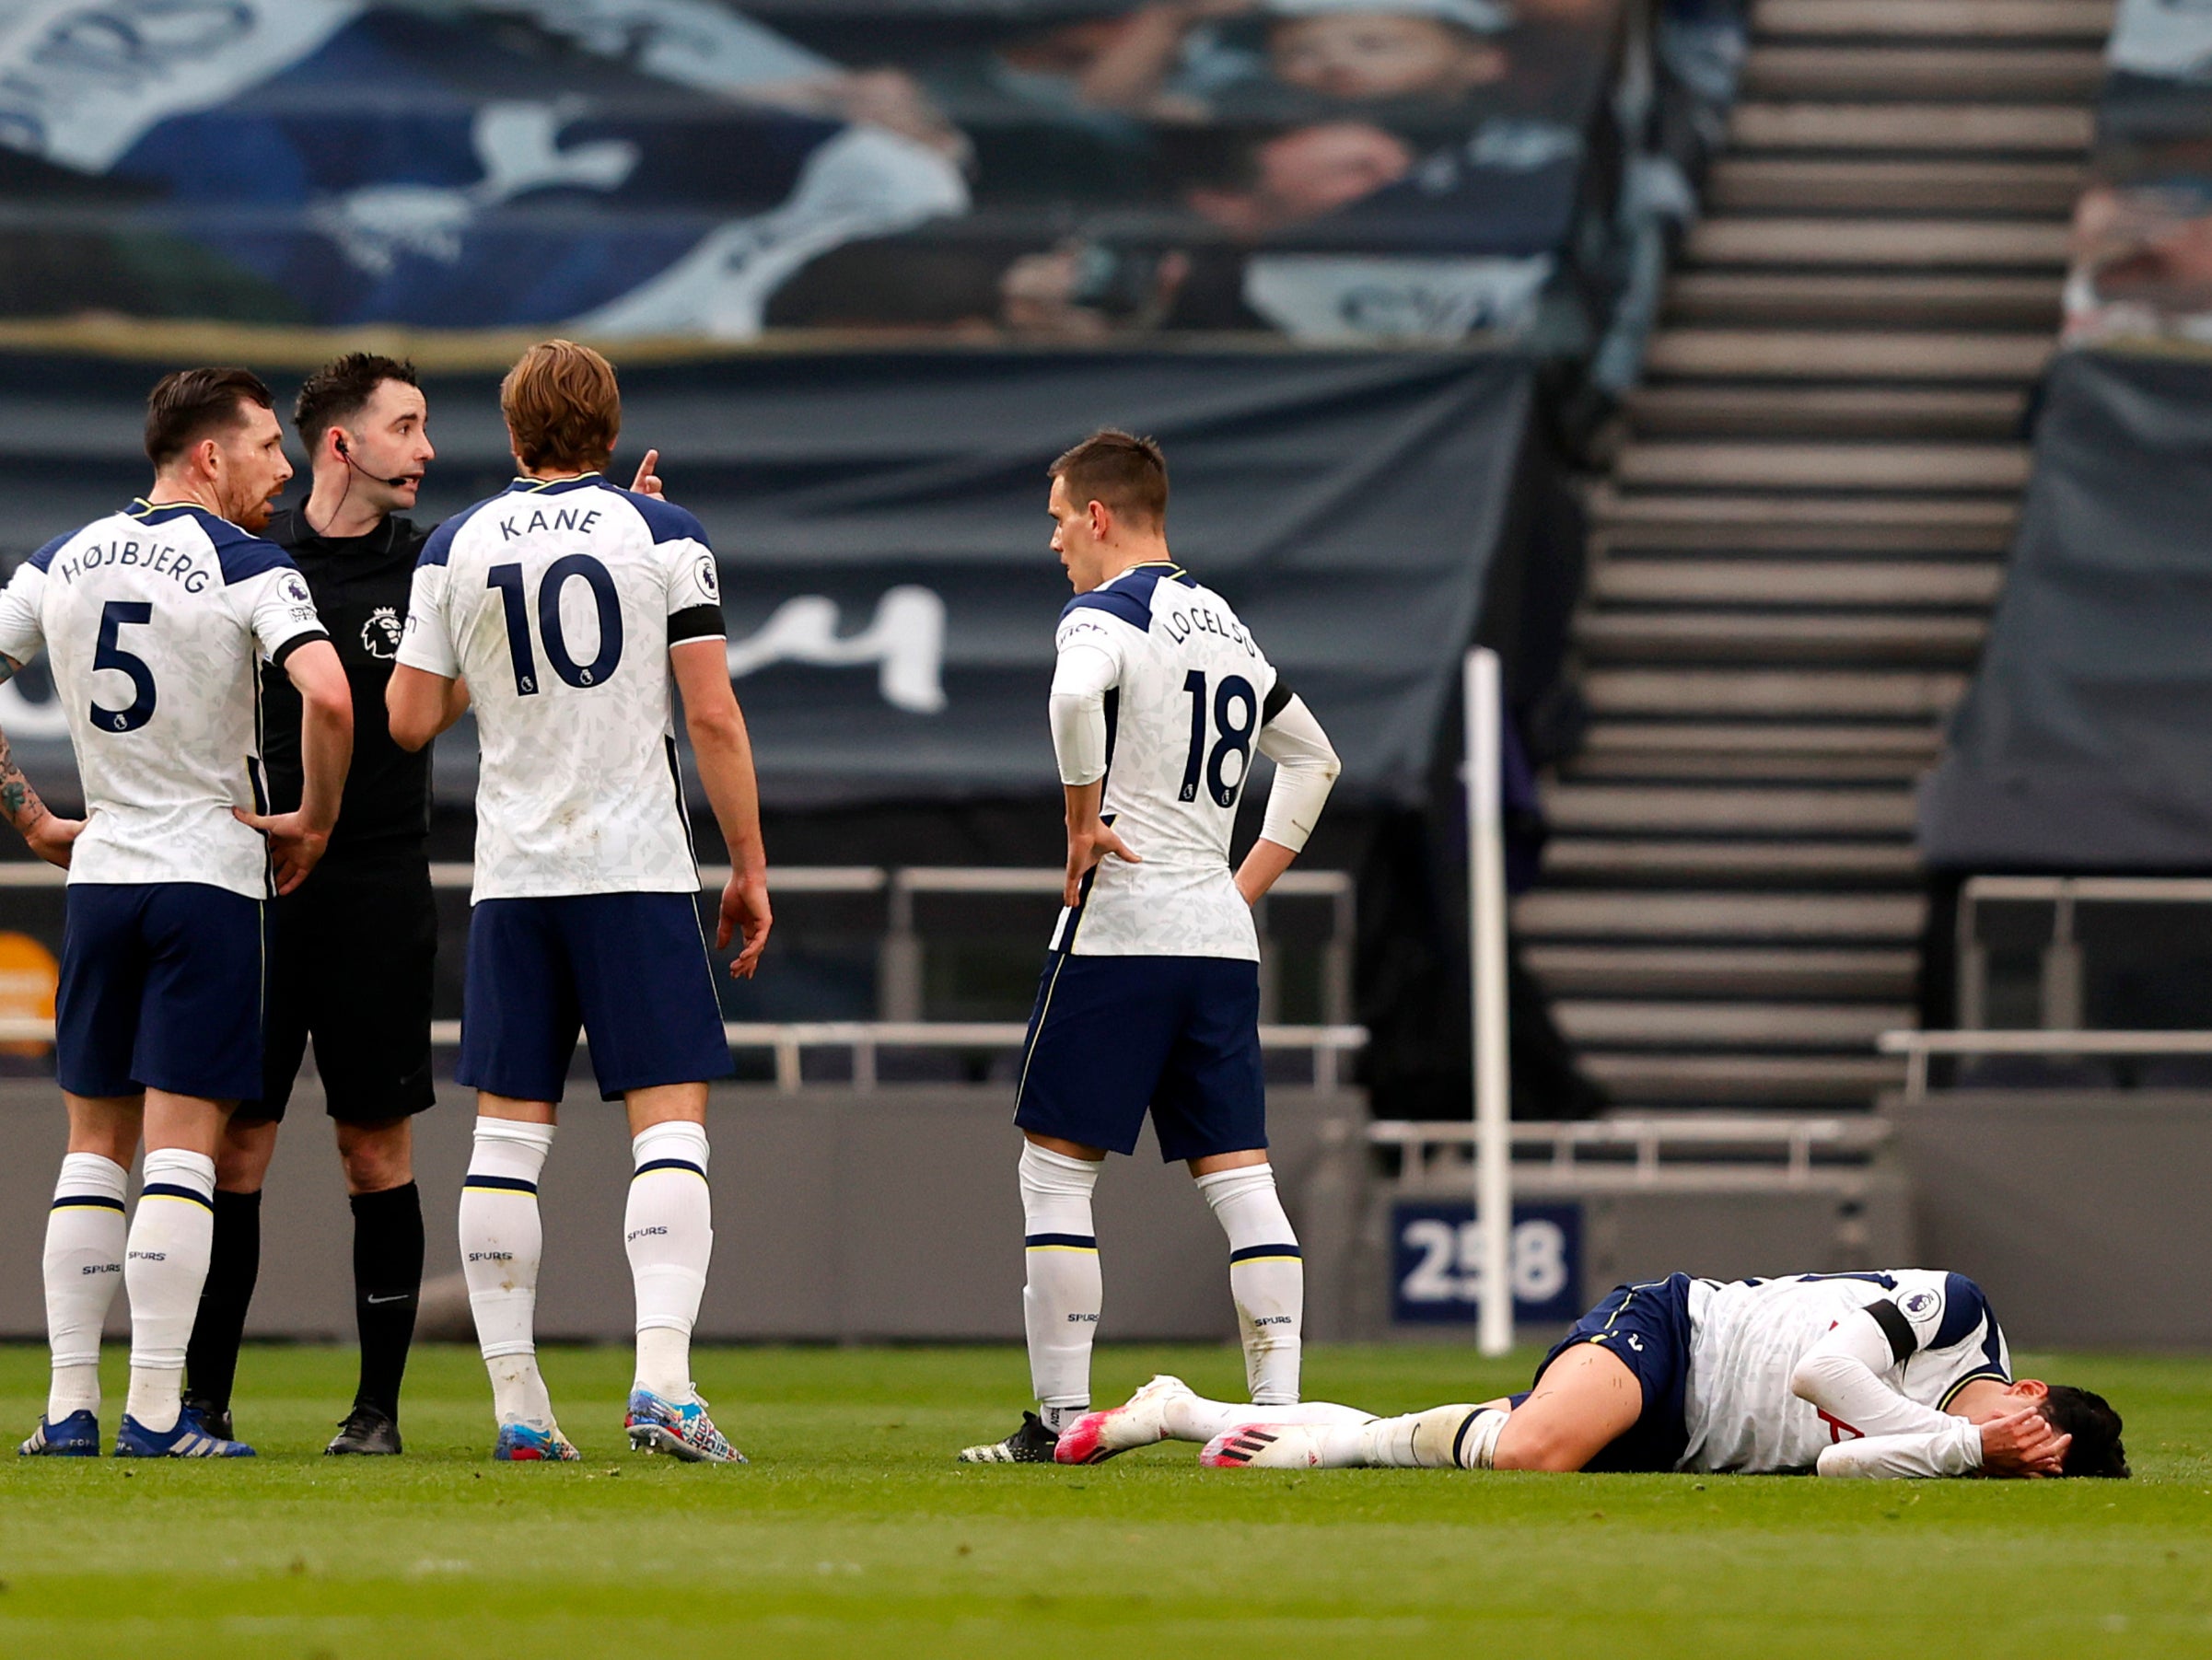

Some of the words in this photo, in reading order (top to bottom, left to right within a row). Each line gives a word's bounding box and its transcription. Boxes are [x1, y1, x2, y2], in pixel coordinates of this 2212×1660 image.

[500, 508, 602, 541] KANE
[62, 540, 210, 594] HØJBJERG
[486, 553, 623, 697] 10
[1162, 611, 1191, 645] LO
[1191, 608, 1255, 658] CELSO
[90, 601, 157, 733] 5
[1178, 669, 1257, 808] 18
[626, 1225, 668, 1242] SPURS
[128, 1251, 167, 1261] SPURS
[469, 1251, 514, 1262] SPURS
[82, 1263, 122, 1275] SPURS
[1067, 1313, 1100, 1322] SPURS
[1254, 1315, 1292, 1327] SPURS
